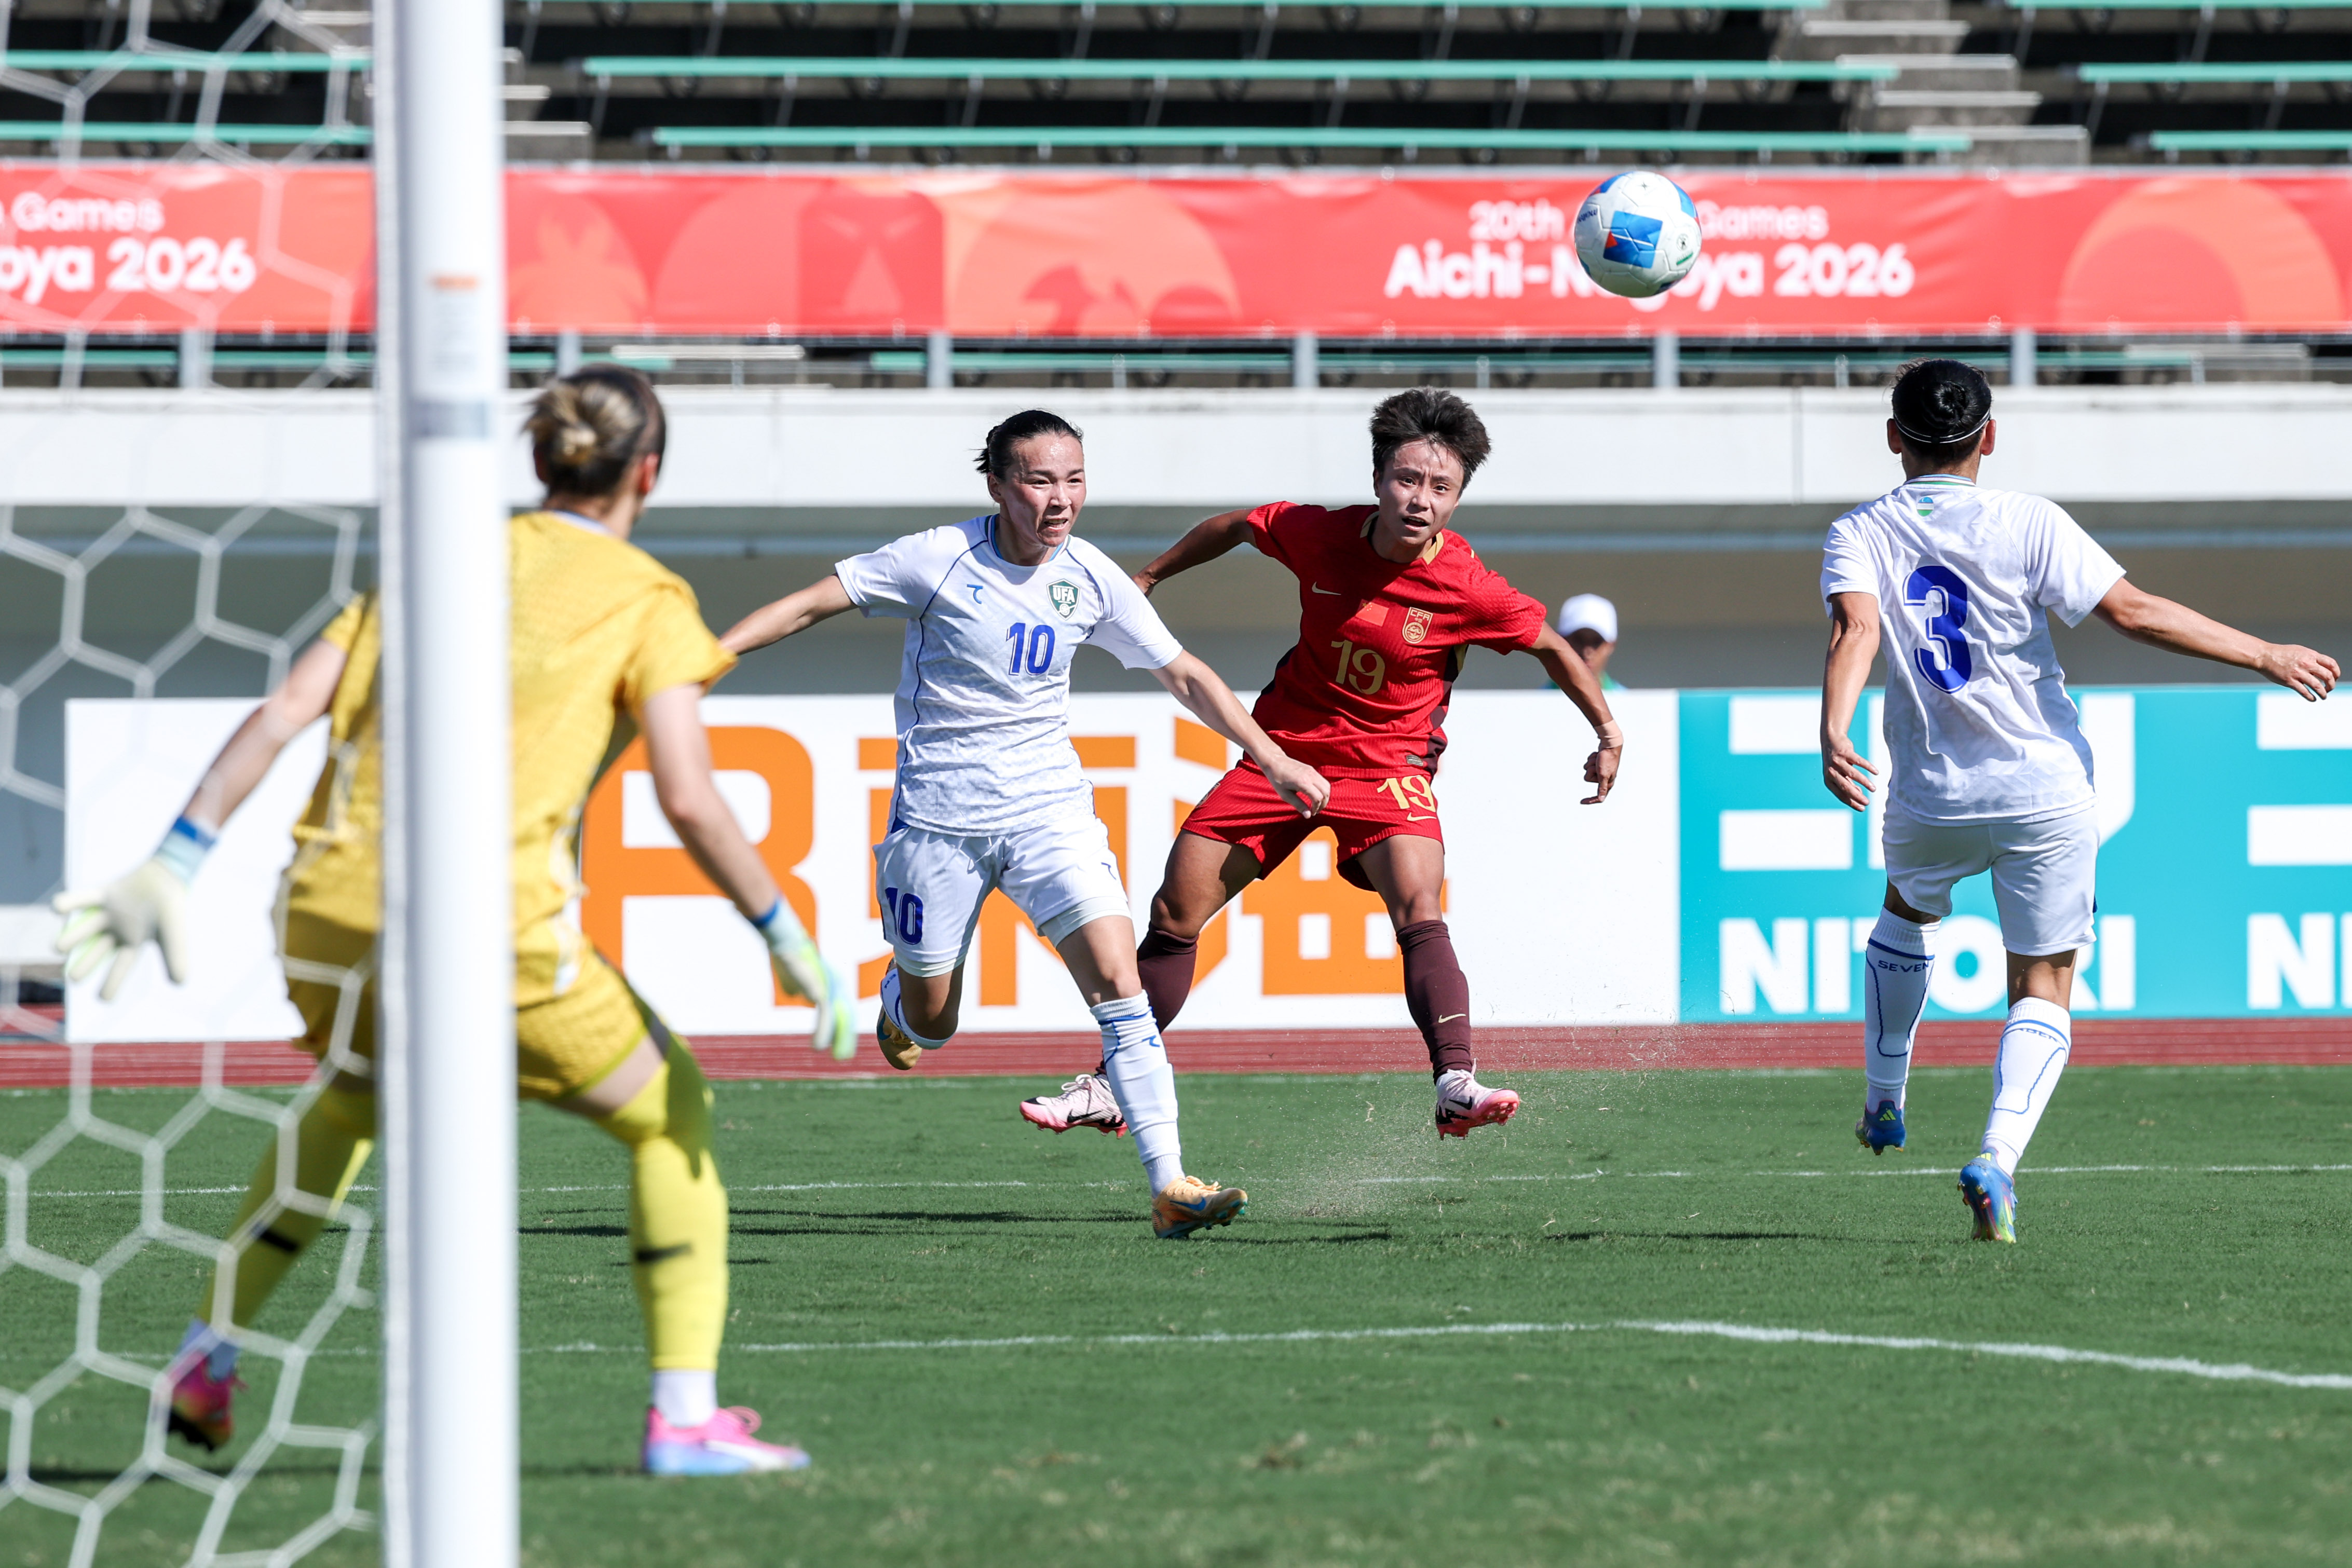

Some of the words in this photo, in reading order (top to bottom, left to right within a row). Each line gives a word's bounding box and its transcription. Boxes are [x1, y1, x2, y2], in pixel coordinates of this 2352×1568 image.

[10, 191, 165, 231] Games
[1469, 199, 1565, 241] 20th
[106, 237, 256, 292] 2026
[1774, 242, 1915, 297] 2026
[1053, 587, 1075, 603] UFA
[1410, 609, 1431, 621] CFA
[1006, 622, 1055, 676] 10
[1903, 565, 1972, 694] 3
[1330, 639, 1385, 694] 19
[1377, 775, 1436, 813] 19
[885, 887, 923, 945] 10
[1719, 915, 2136, 1015] NIOI
[1878, 960, 1929, 972] SEVEN
